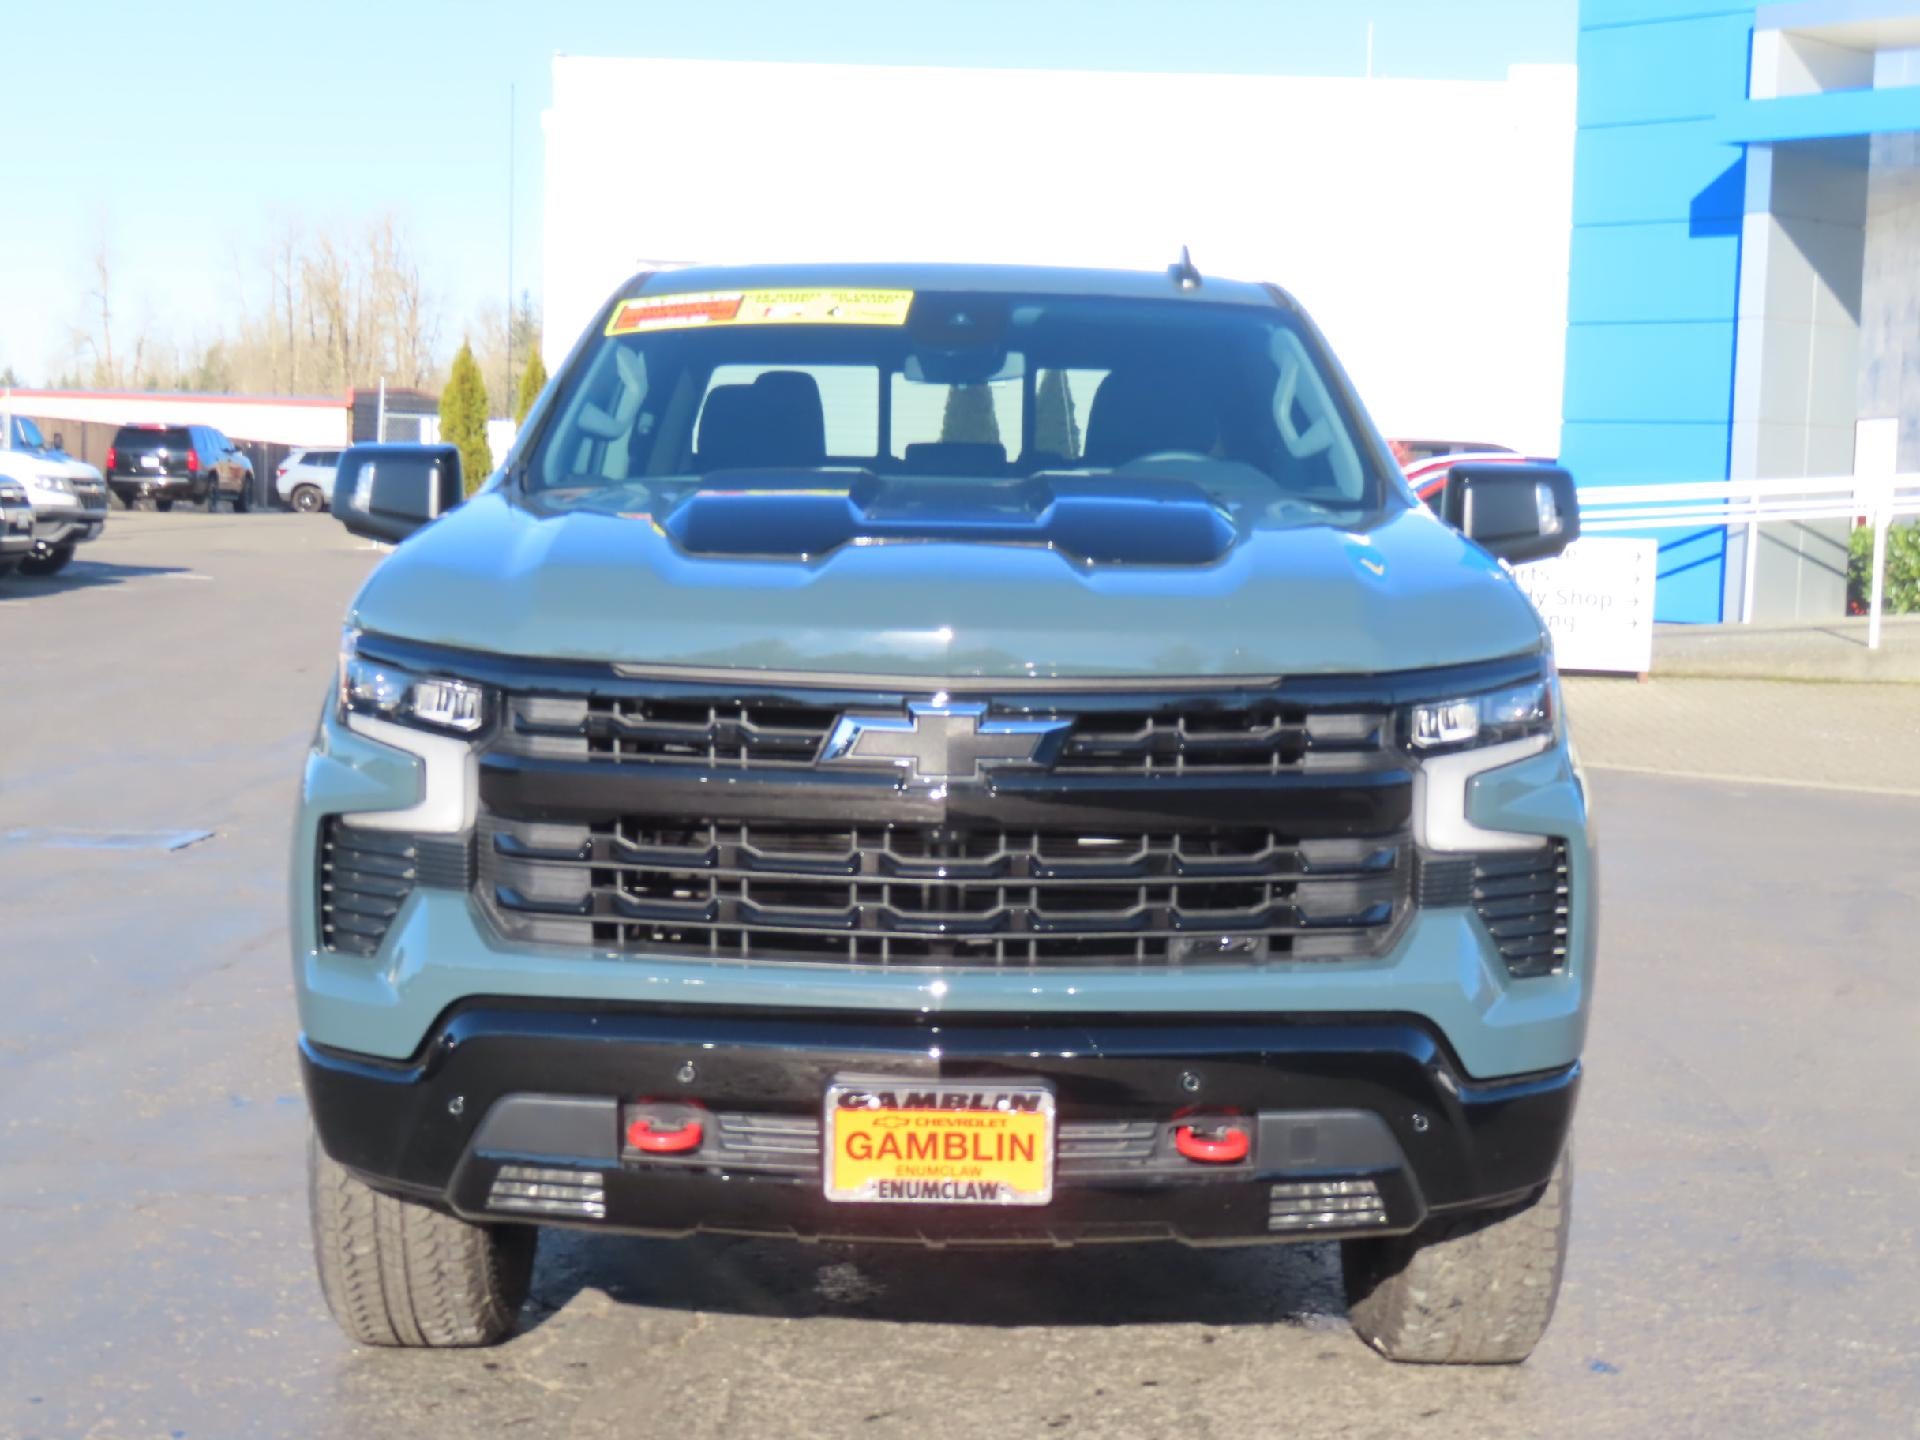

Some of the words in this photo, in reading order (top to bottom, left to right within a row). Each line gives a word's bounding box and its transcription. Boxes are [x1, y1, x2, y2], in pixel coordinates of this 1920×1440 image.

[1557, 589, 1613, 611] Shop
[915, 1116, 1008, 1129] CHEVROLET
[845, 1131, 1035, 1162] GAMBLIN
[895, 1164, 983, 1178] ENUMCLAW
[878, 1179, 999, 1201] ENUMCLAW
